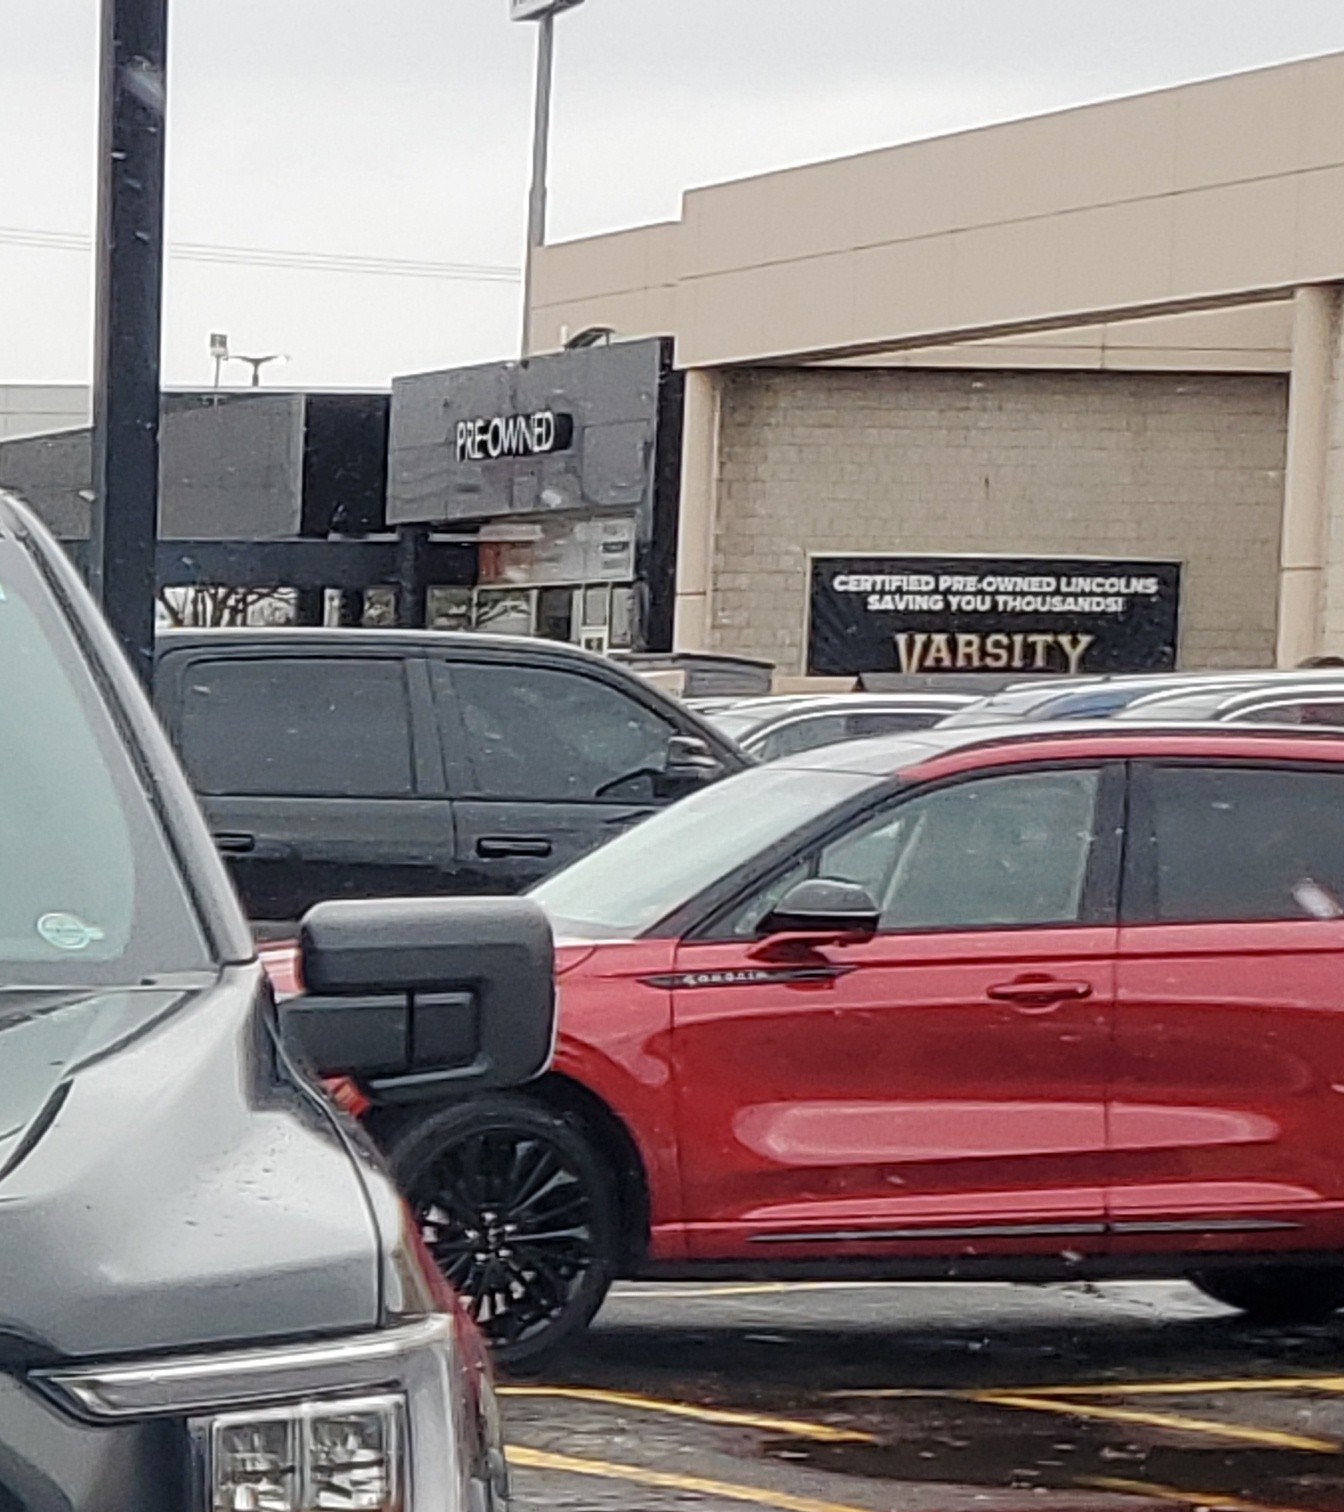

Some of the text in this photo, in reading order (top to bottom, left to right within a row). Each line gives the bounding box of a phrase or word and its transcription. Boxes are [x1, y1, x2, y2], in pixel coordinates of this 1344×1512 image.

[456, 411, 555, 462] PRE-OWNED
[833, 575, 1159, 595] CERTIFIED PRE-OWNED LINCOLNS
[866, 595, 1124, 613] SAVING YOU THOUSANDS!
[895, 633, 1095, 674] VARSITY
